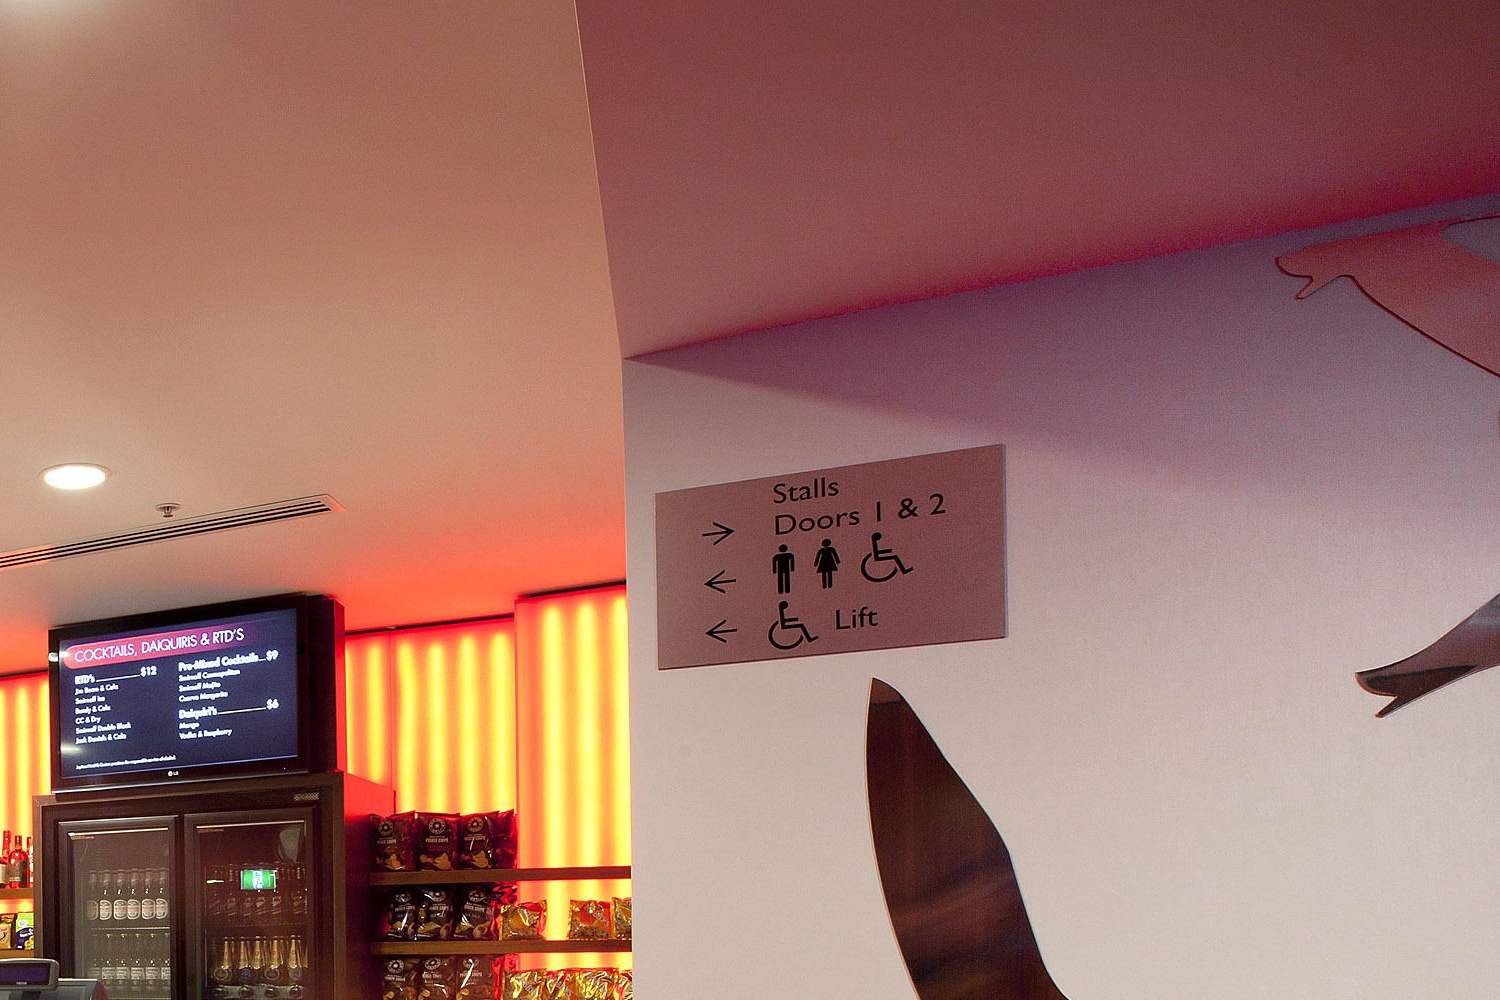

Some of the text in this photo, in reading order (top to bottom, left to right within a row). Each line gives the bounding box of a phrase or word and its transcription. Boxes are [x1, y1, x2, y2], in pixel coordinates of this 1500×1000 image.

[773, 477, 839, 503] Stalls
[775, 510, 860, 535] Doors
[898, 498, 918, 520] &
[930, 493, 946, 515] 2
[836, 606, 879, 630] Lift
[74, 628, 245, 662] COCKTAILS, DAIQUIRIS & RTD'S
[140, 666, 157, 677] $12
[221, 652, 259, 666] Cocktails
